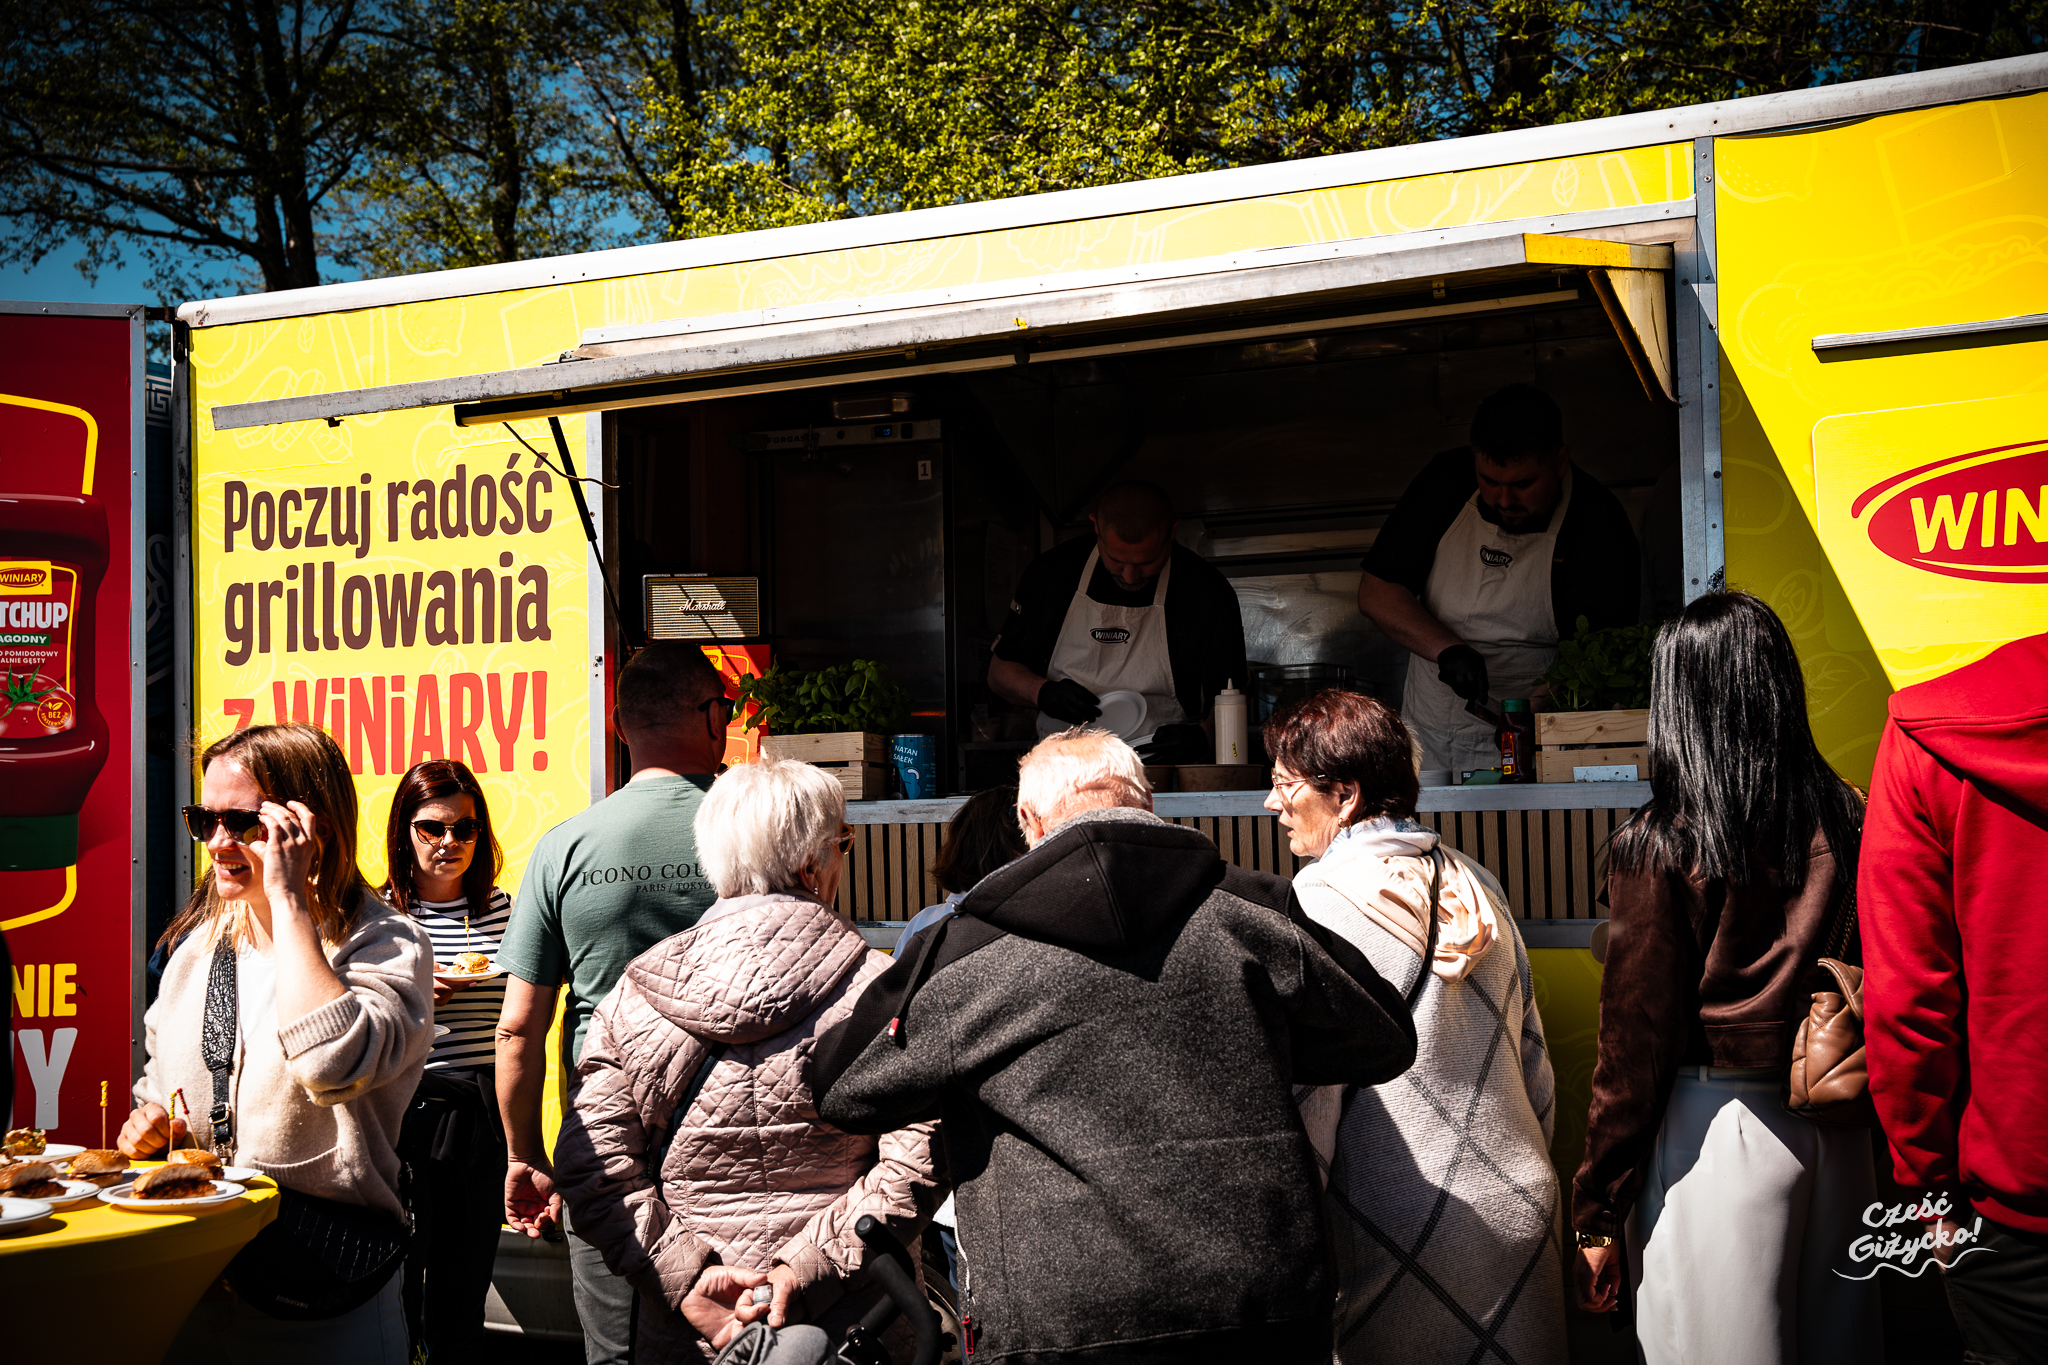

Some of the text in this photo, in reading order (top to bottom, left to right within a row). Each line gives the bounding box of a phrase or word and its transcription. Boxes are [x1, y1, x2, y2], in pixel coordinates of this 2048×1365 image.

[921, 463, 929, 477] 1
[224, 452, 553, 559] Poczuj radość
[1910, 484, 2048, 553] WIN
[0, 573, 44, 583] WINIARY
[224, 551, 551, 667] grillowania
[679, 598, 727, 611] Marshall
[1095, 630, 1129, 640] WINIARY
[23, 657, 46, 665] GĘSTY
[48, 711, 61, 719] BEZ
[894, 744, 919, 757] NATAN
[580, 864, 652, 887] ICONO
[636, 882, 666, 893] PARIS
[676, 881, 711, 891] TOKYO
